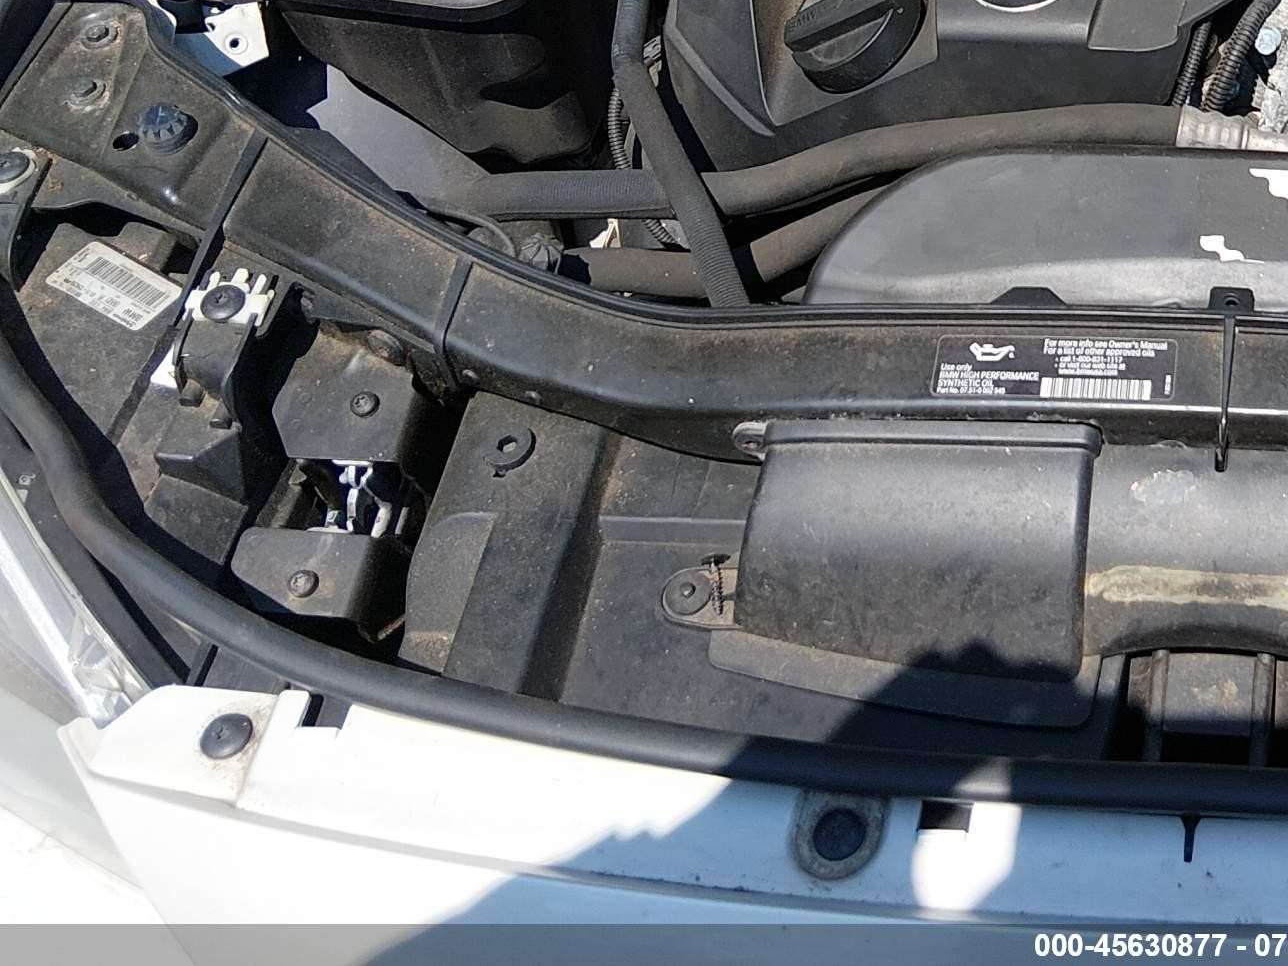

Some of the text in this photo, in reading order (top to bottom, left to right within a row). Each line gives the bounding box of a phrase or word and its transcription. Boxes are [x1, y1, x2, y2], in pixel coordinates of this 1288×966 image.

[1044, 338, 1057, 347] For
[1079, 338, 1094, 348] info
[1109, 340, 1138, 349] Owner's
[1140, 340, 1167, 350] Manual
[1106, 348, 1141, 357] approved
[956, 363, 972, 371] only
[960, 371, 980, 379] HIGH
[981, 372, 1039, 381] PERFORMANCE
[938, 378, 980, 386] SYNTHETIC
